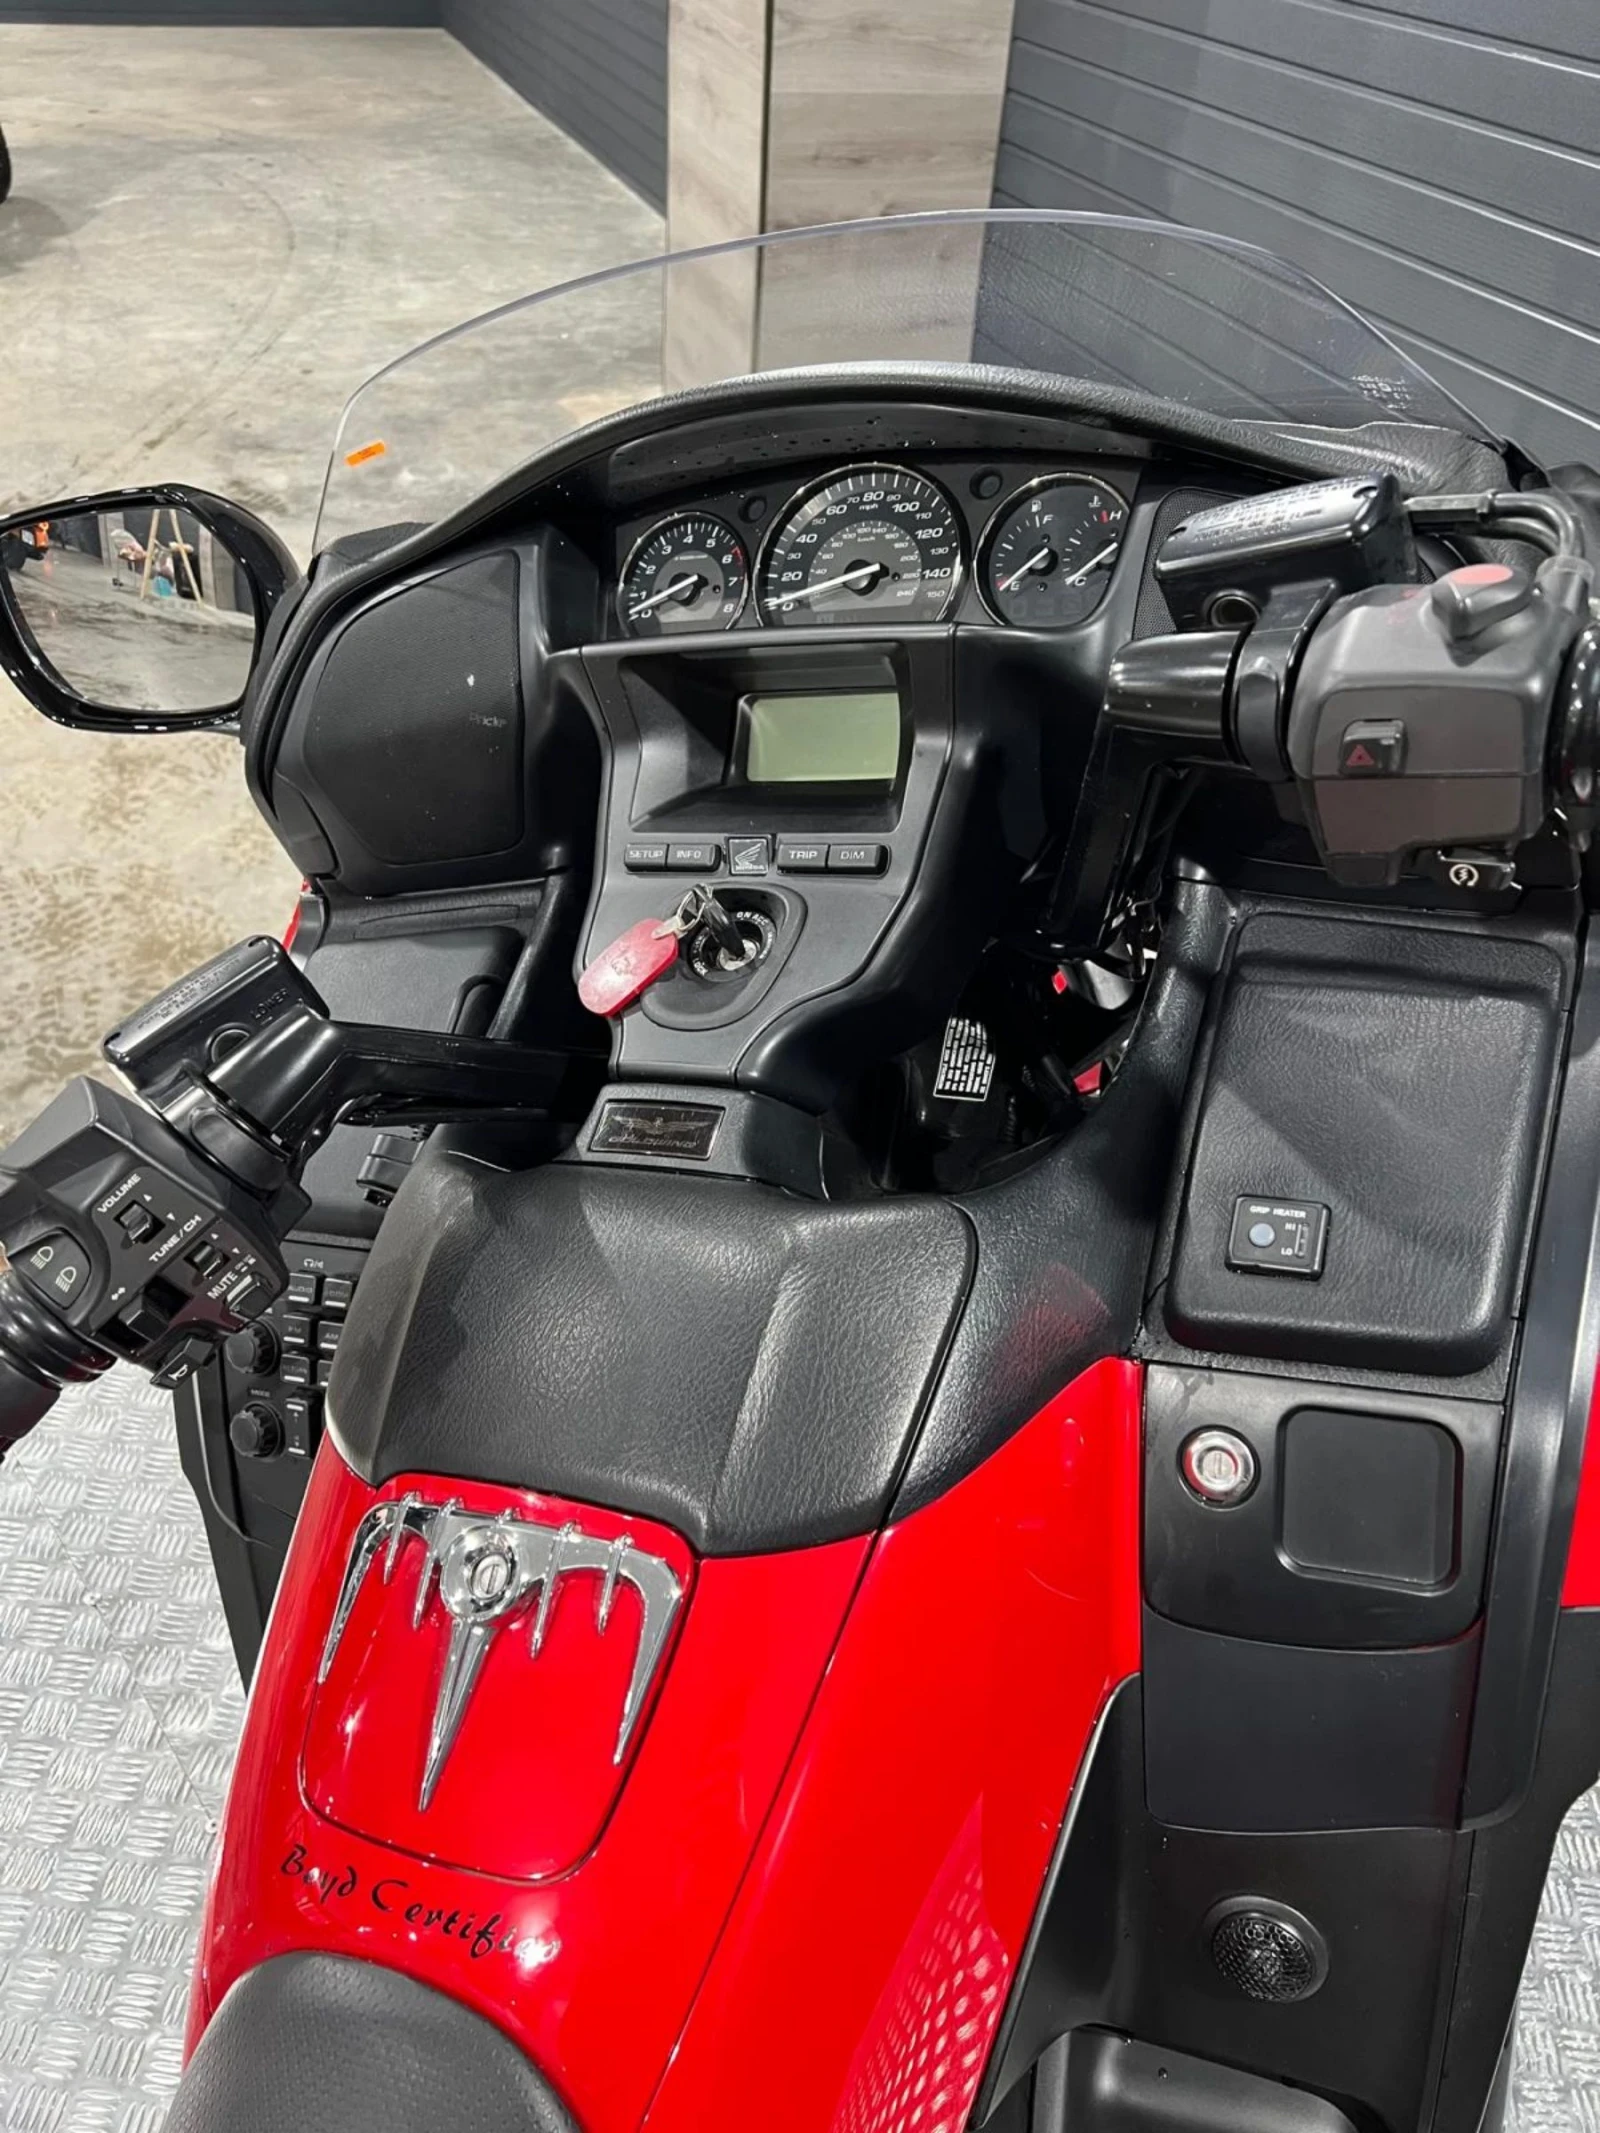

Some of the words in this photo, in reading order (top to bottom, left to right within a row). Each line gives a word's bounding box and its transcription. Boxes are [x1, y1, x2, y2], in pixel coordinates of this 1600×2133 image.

[847, 496, 860, 504] 70
[863, 491, 884, 501] 80
[826, 505, 847, 515] 60
[859, 503, 878, 511] mph
[892, 501, 920, 513] 100
[915, 512, 932, 520] 110
[1042, 514, 1054, 524] F
[1109, 510, 1122, 521] H
[812, 518, 826, 526] 50
[796, 534, 818, 543] 40
[915, 528, 943, 539] 120
[683, 535, 694, 544] 4
[706, 538, 716, 548] 5
[661, 545, 672, 555] 3
[930, 547, 949, 555] 130
[722, 554, 732, 564] 6
[787, 552, 802, 560] 30
[645, 565, 656, 575] 2
[922, 567, 951, 579] 140
[728, 577, 738, 586] 7
[781, 571, 802, 582] 20
[1074, 577, 1087, 586] C
[1010, 581, 1021, 591] E
[640, 591, 647, 600] 1
[926, 590, 945, 598] 150
[723, 603, 734, 613] 8
[782, 602, 794, 611] 0
[641, 609, 652, 618] 0
[629, 849, 663, 858] SETUP
[676, 849, 701, 859] INFO
[789, 850, 818, 859] TRIP
[840, 850, 865, 860] DIM
[97, 1173, 141, 1213] VOLUME
[1249, 1205, 1270, 1214] GRIP
[1273, 1208, 1306, 1219] HEATER
[1285, 1222, 1296, 1231] HI
[149, 1214, 202, 1262] TUNE/CH
[1281, 1247, 1293, 1256] LO
[207, 1271, 238, 1299] MUTE
